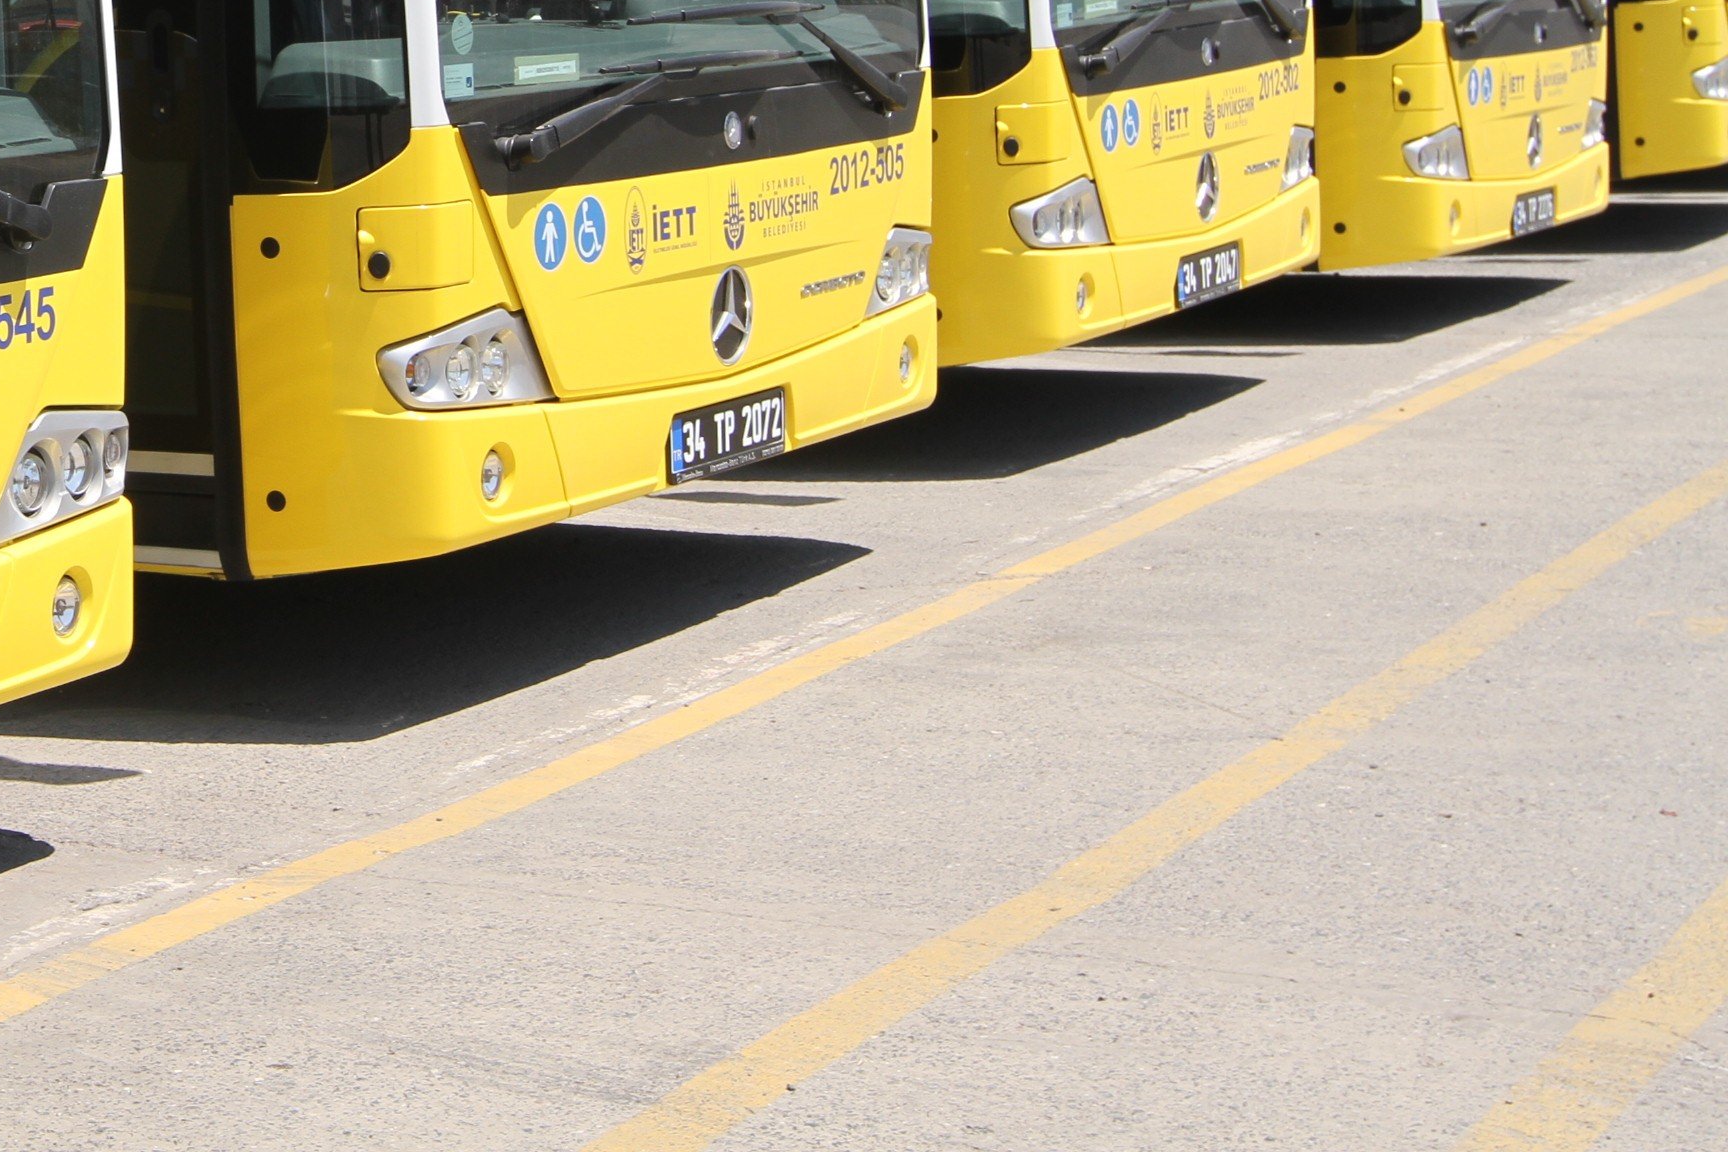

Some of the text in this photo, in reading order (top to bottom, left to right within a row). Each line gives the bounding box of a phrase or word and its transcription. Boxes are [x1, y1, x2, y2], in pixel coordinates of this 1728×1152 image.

[1258, 63, 1299, 101] 2012-502
[1165, 105, 1189, 132] İETT
[761, 176, 805, 191] İSTANBUL
[829, 143, 904, 196] 2012-505
[652, 204, 697, 242] İETT
[749, 185, 819, 223] BÜYÜKŞEHİR
[763, 218, 807, 238] BELEDİYESİ
[1183, 249, 1236, 294] 34 TP 2047
[683, 397, 782, 463] 34 TP 2072
